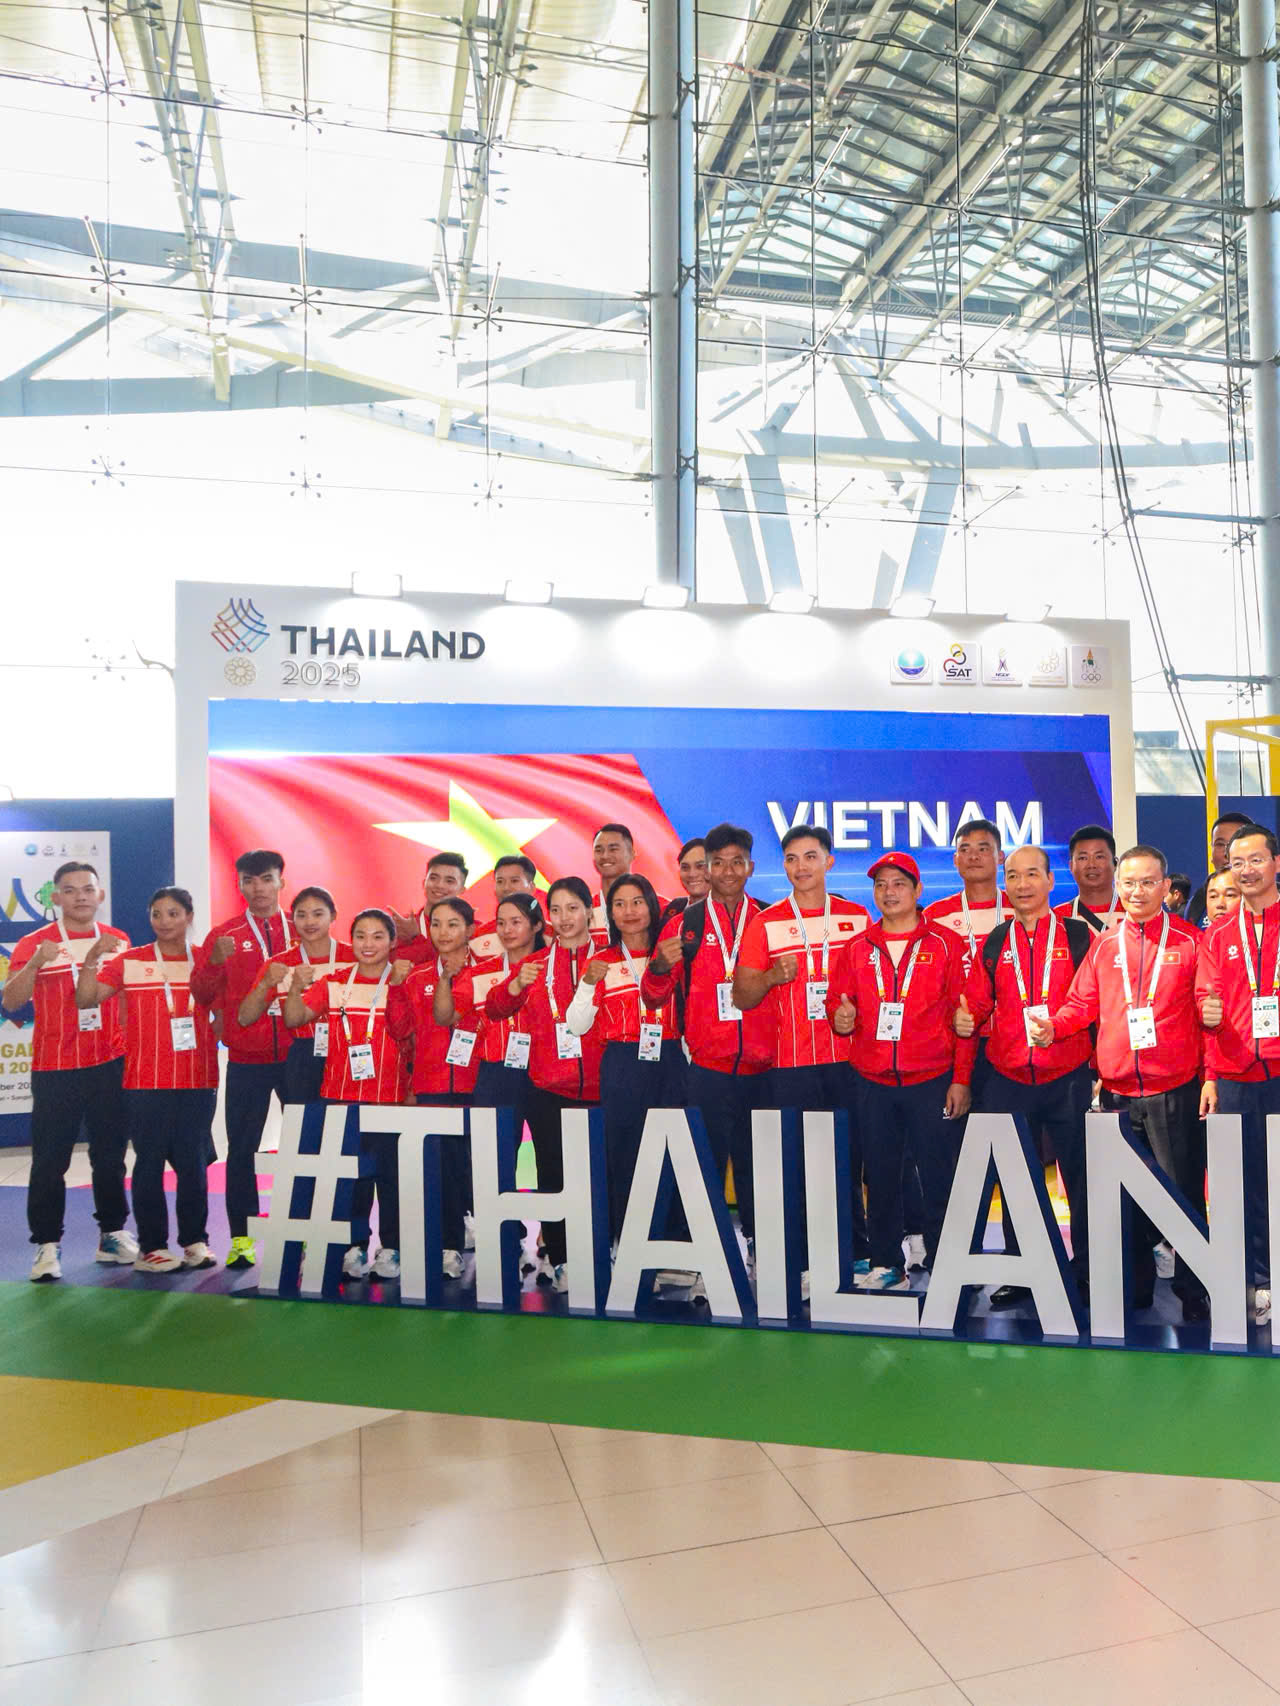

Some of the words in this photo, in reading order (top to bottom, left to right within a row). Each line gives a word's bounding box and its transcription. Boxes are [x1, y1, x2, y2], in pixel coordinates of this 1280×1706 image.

[280, 624, 486, 660] THAILAND
[280, 660, 361, 687] 2025
[946, 668, 972, 677] SAT
[767, 801, 1043, 848] VIETNAM
